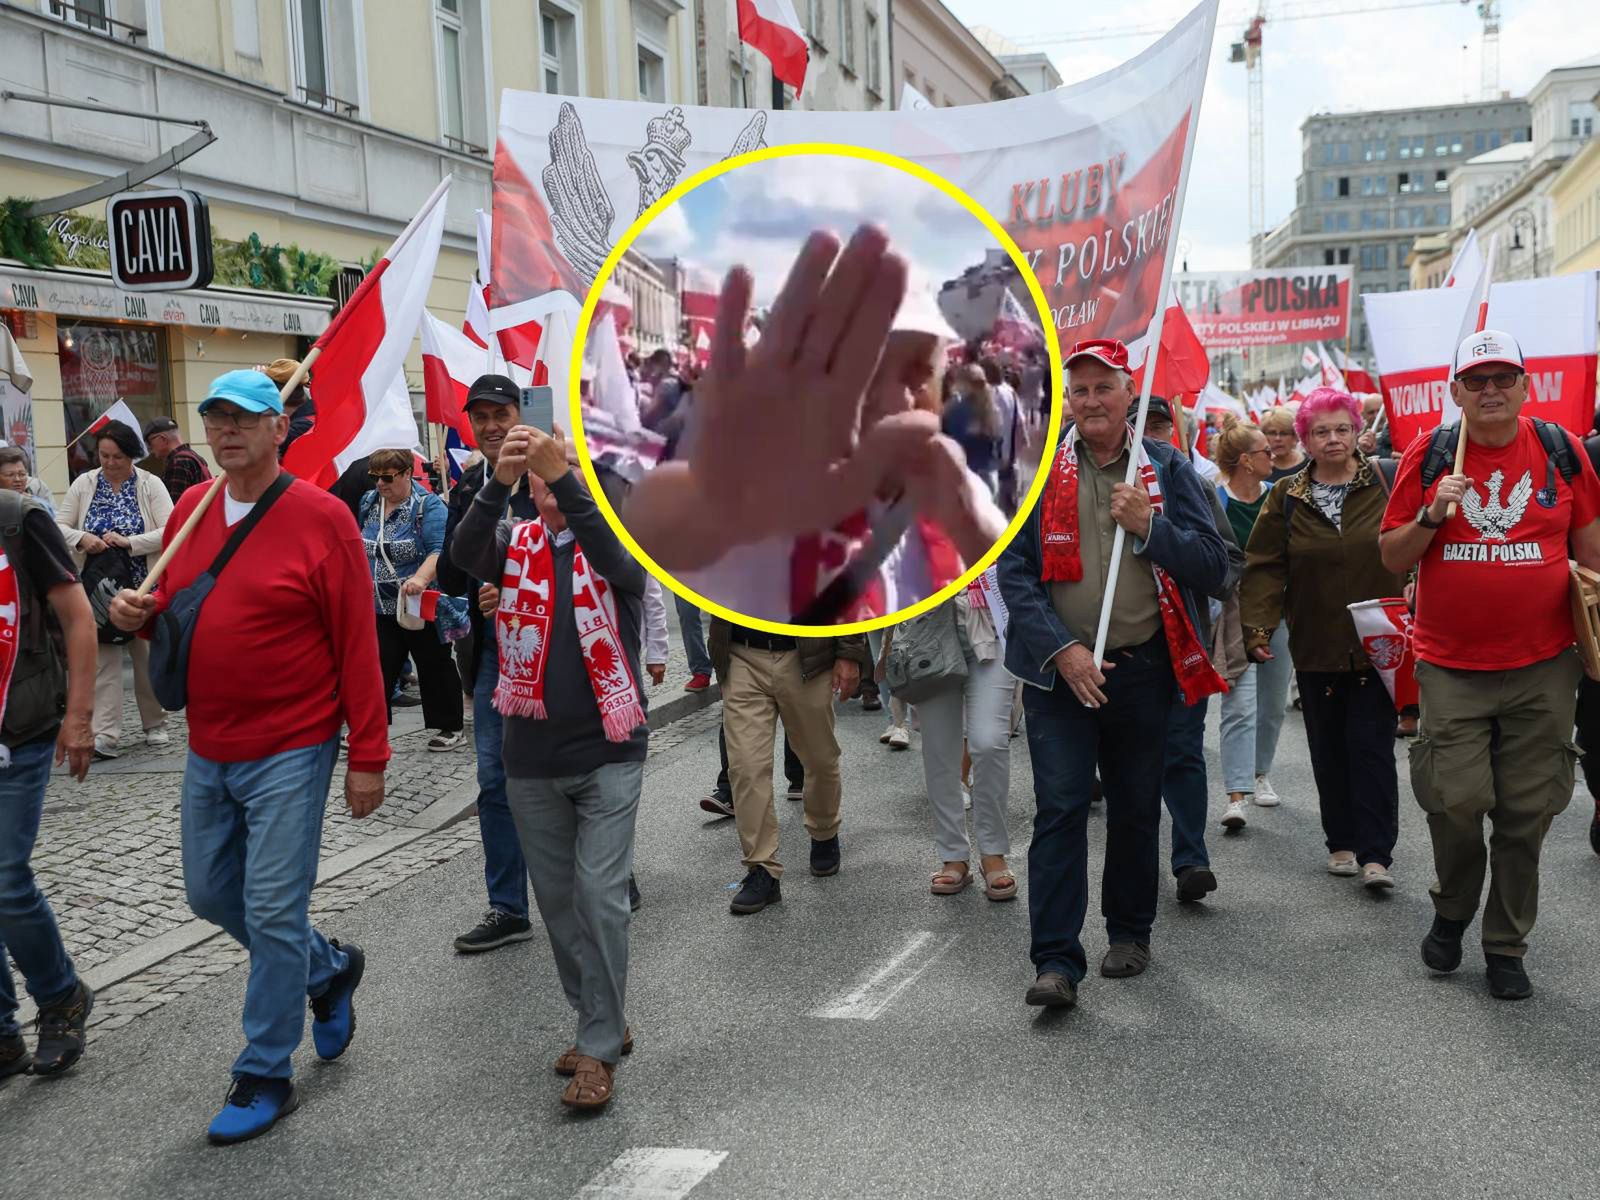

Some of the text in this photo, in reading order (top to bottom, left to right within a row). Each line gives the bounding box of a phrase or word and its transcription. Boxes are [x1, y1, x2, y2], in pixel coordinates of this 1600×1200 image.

[1009, 152, 1126, 225] KLUBY
[120, 206, 185, 275] CAVA
[11, 283, 39, 308] CAVA
[1249, 274, 1339, 314] POLSKA
[125, 296, 147, 319] CAVA
[163, 309, 184, 321] evian
[200, 304, 220, 325] CAVA
[1050, 297, 1099, 329] OCŁAW
[283, 313, 302, 332] CAVA
[1218, 321, 1274, 334] POLSKIEJ
[1277, 319, 1290, 331] W
[1443, 542, 1543, 562] GAZETA POLSKA
[502, 598, 545, 614] IAŁO
